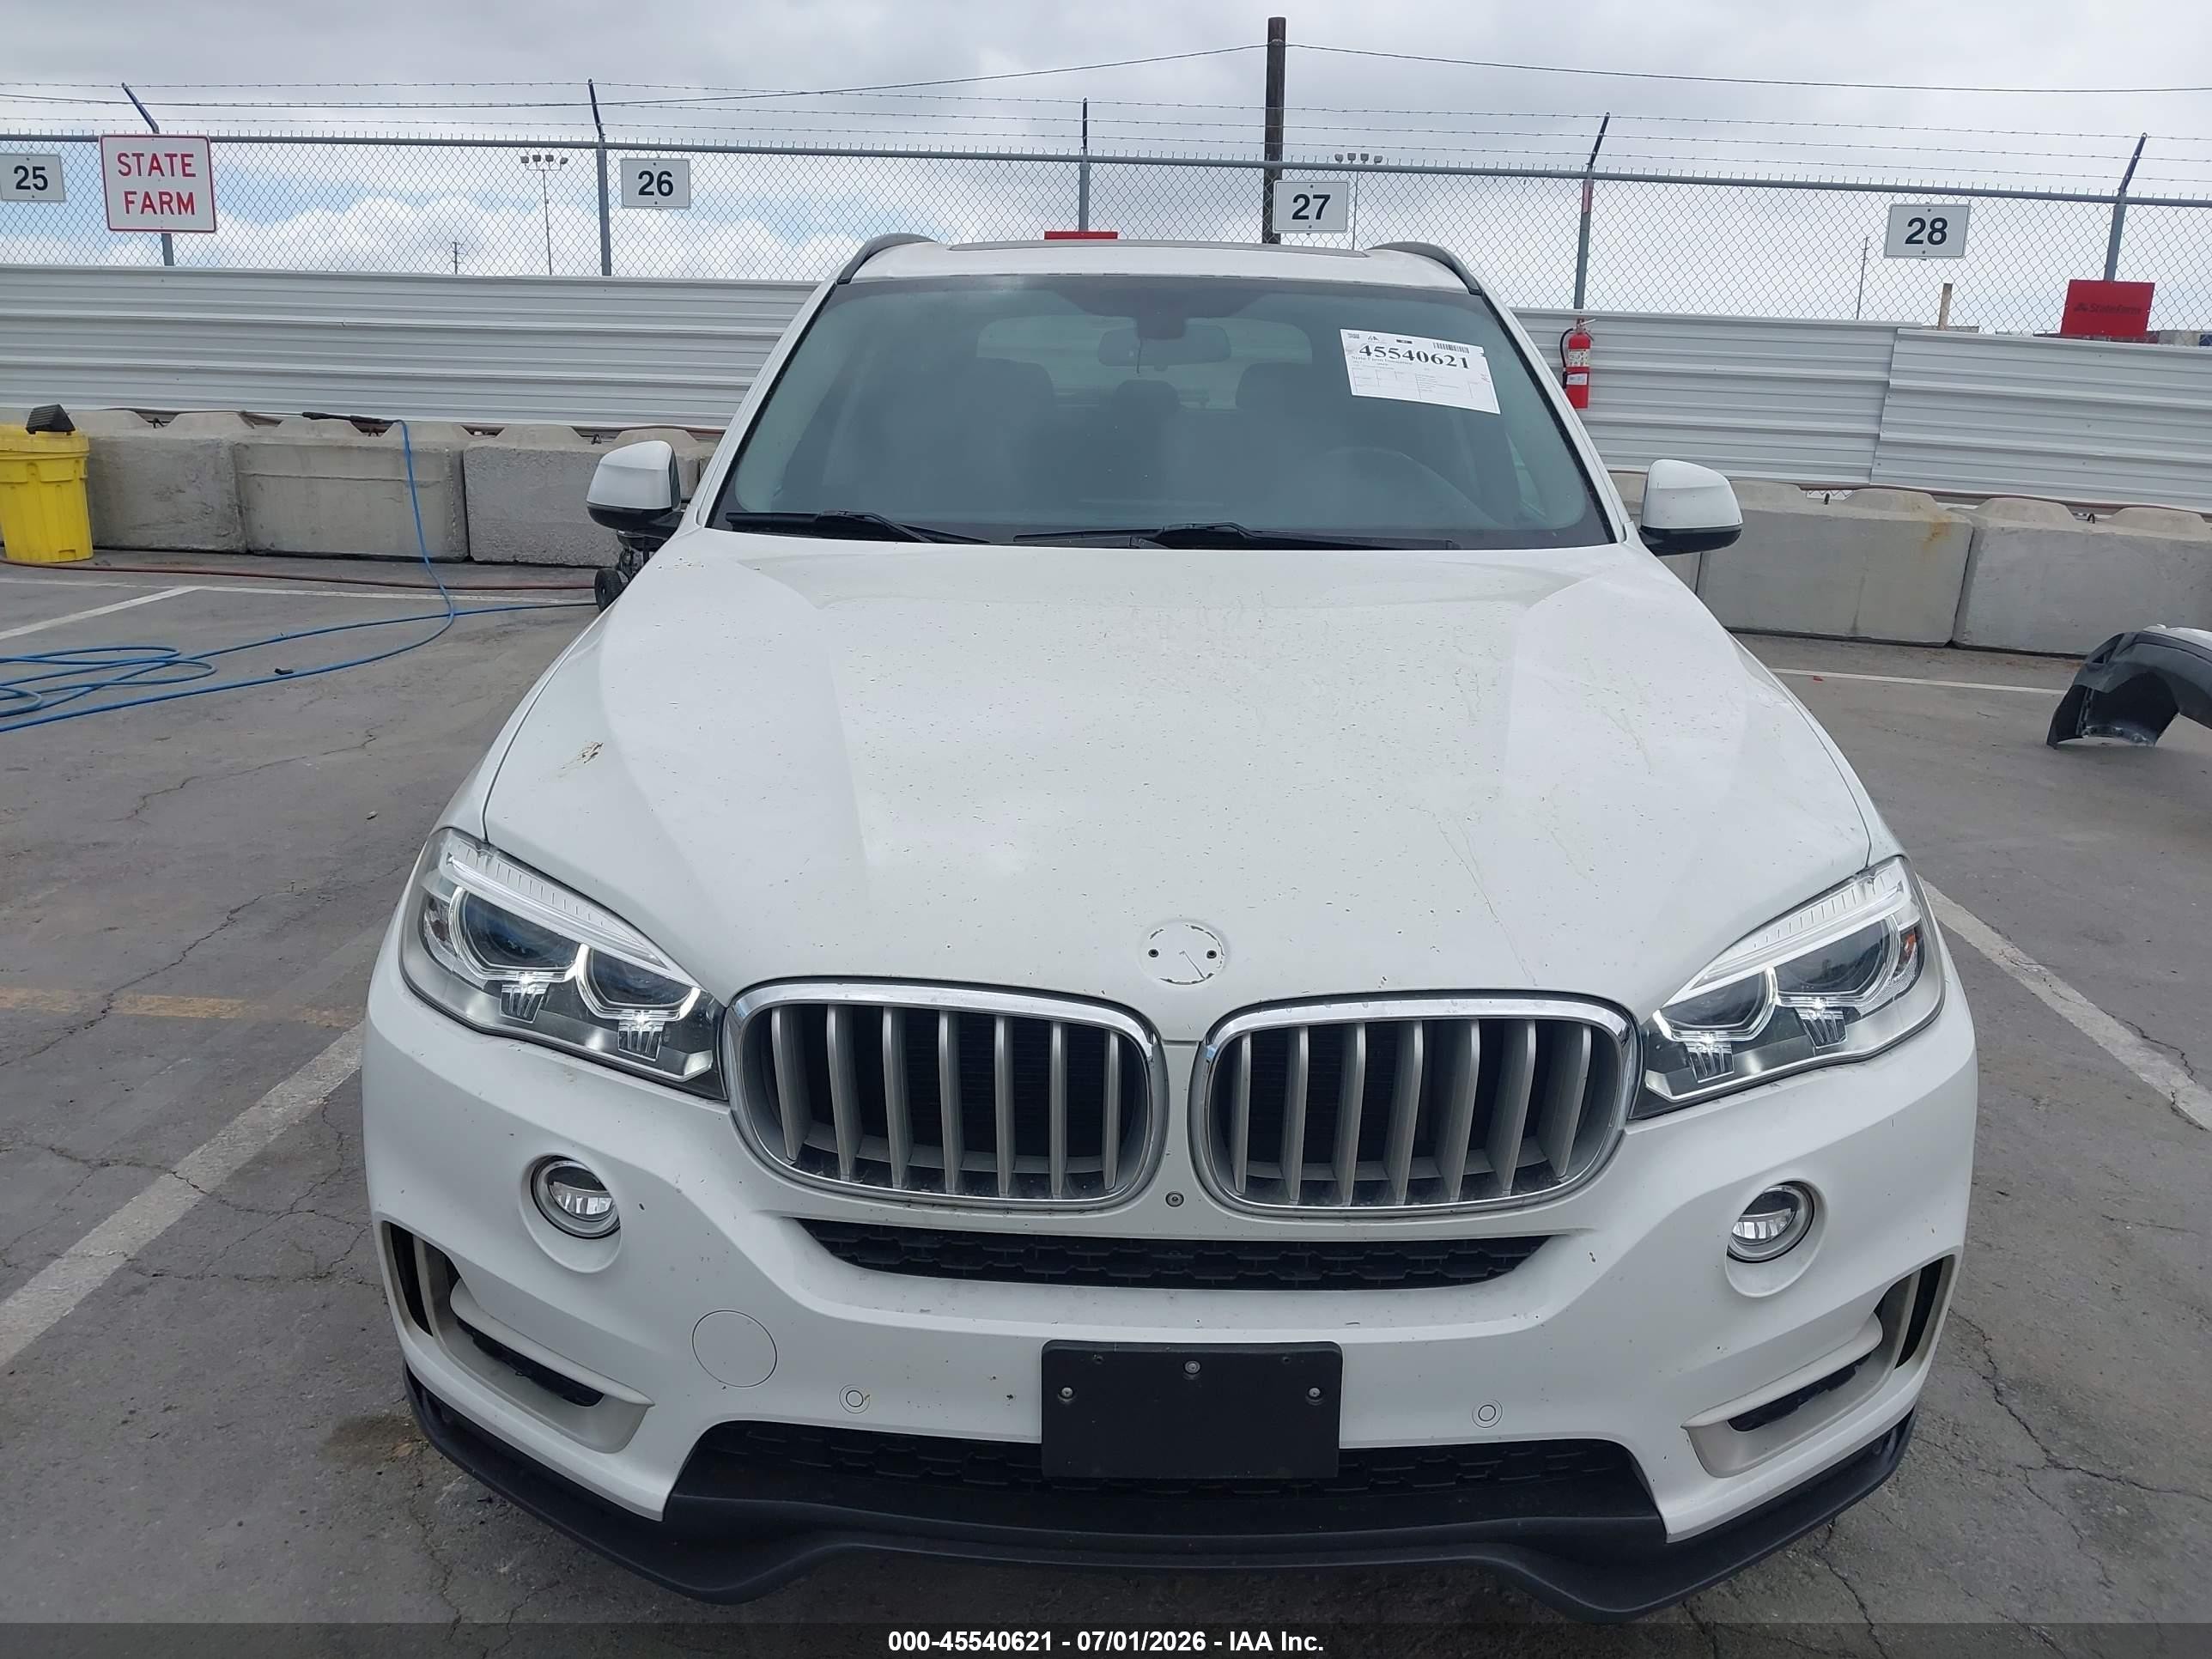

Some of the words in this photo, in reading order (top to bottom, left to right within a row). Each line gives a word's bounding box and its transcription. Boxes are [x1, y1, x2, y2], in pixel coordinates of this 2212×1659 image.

[13, 165, 48, 191] 25
[117, 152, 197, 178] STATE
[638, 170, 674, 197] 26
[123, 191, 196, 216] FARM
[1291, 193, 1331, 220] 27
[1905, 217, 1948, 246] 28
[1359, 345, 1470, 369] 45540621
